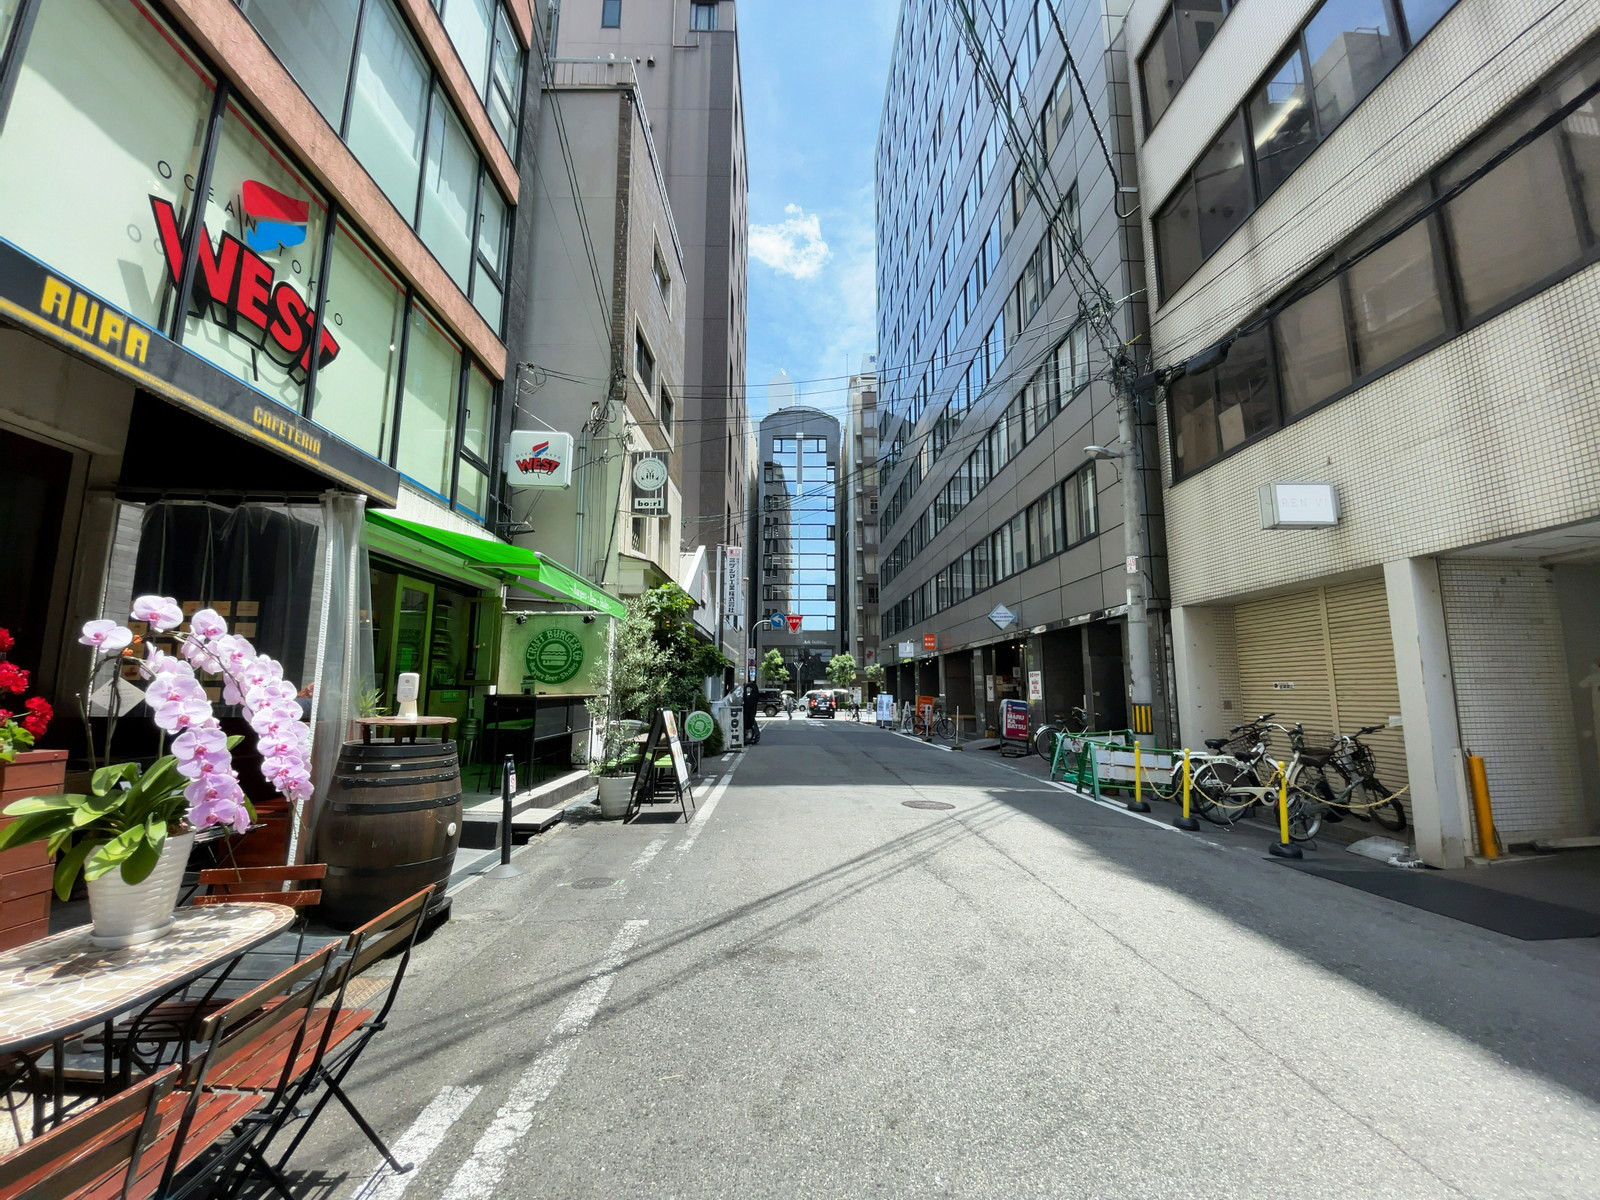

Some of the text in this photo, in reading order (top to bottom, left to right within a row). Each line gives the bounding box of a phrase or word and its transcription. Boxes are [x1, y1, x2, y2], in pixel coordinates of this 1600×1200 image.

[149, 194, 340, 386] WEST
[277, 242, 344, 326] TOKO
[40, 275, 151, 364] AUPA
[252, 405, 321, 455] CAFETERIA
[515, 457, 560, 475] WEST
[526, 633, 545, 660] CRAFT
[546, 629, 581, 651] BURGER
[730, 708, 743, 748] bo:rl
